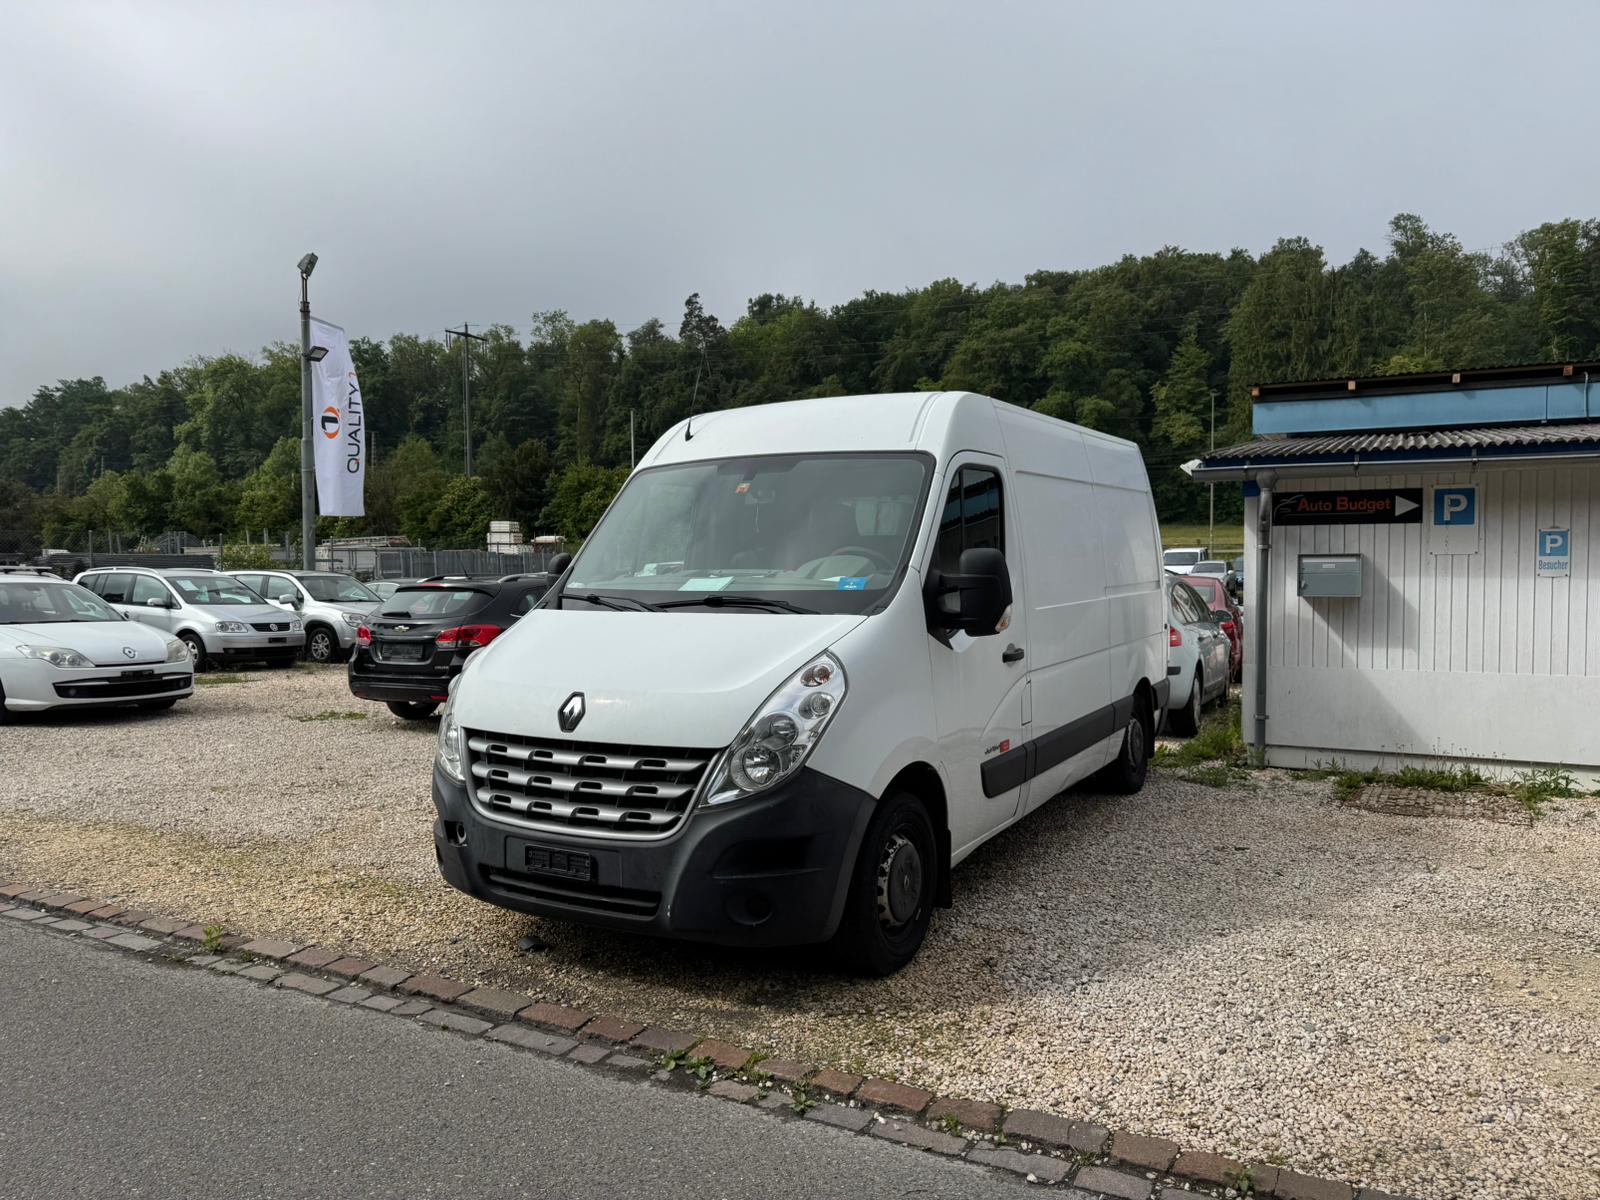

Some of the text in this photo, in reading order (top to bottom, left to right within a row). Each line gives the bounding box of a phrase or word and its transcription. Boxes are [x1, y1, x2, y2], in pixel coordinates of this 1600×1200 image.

[1298, 496, 1392, 512] Auto Budget
[1444, 494, 1467, 520] P
[1545, 534, 1563, 554] P
[1538, 560, 1568, 570] Besucher
